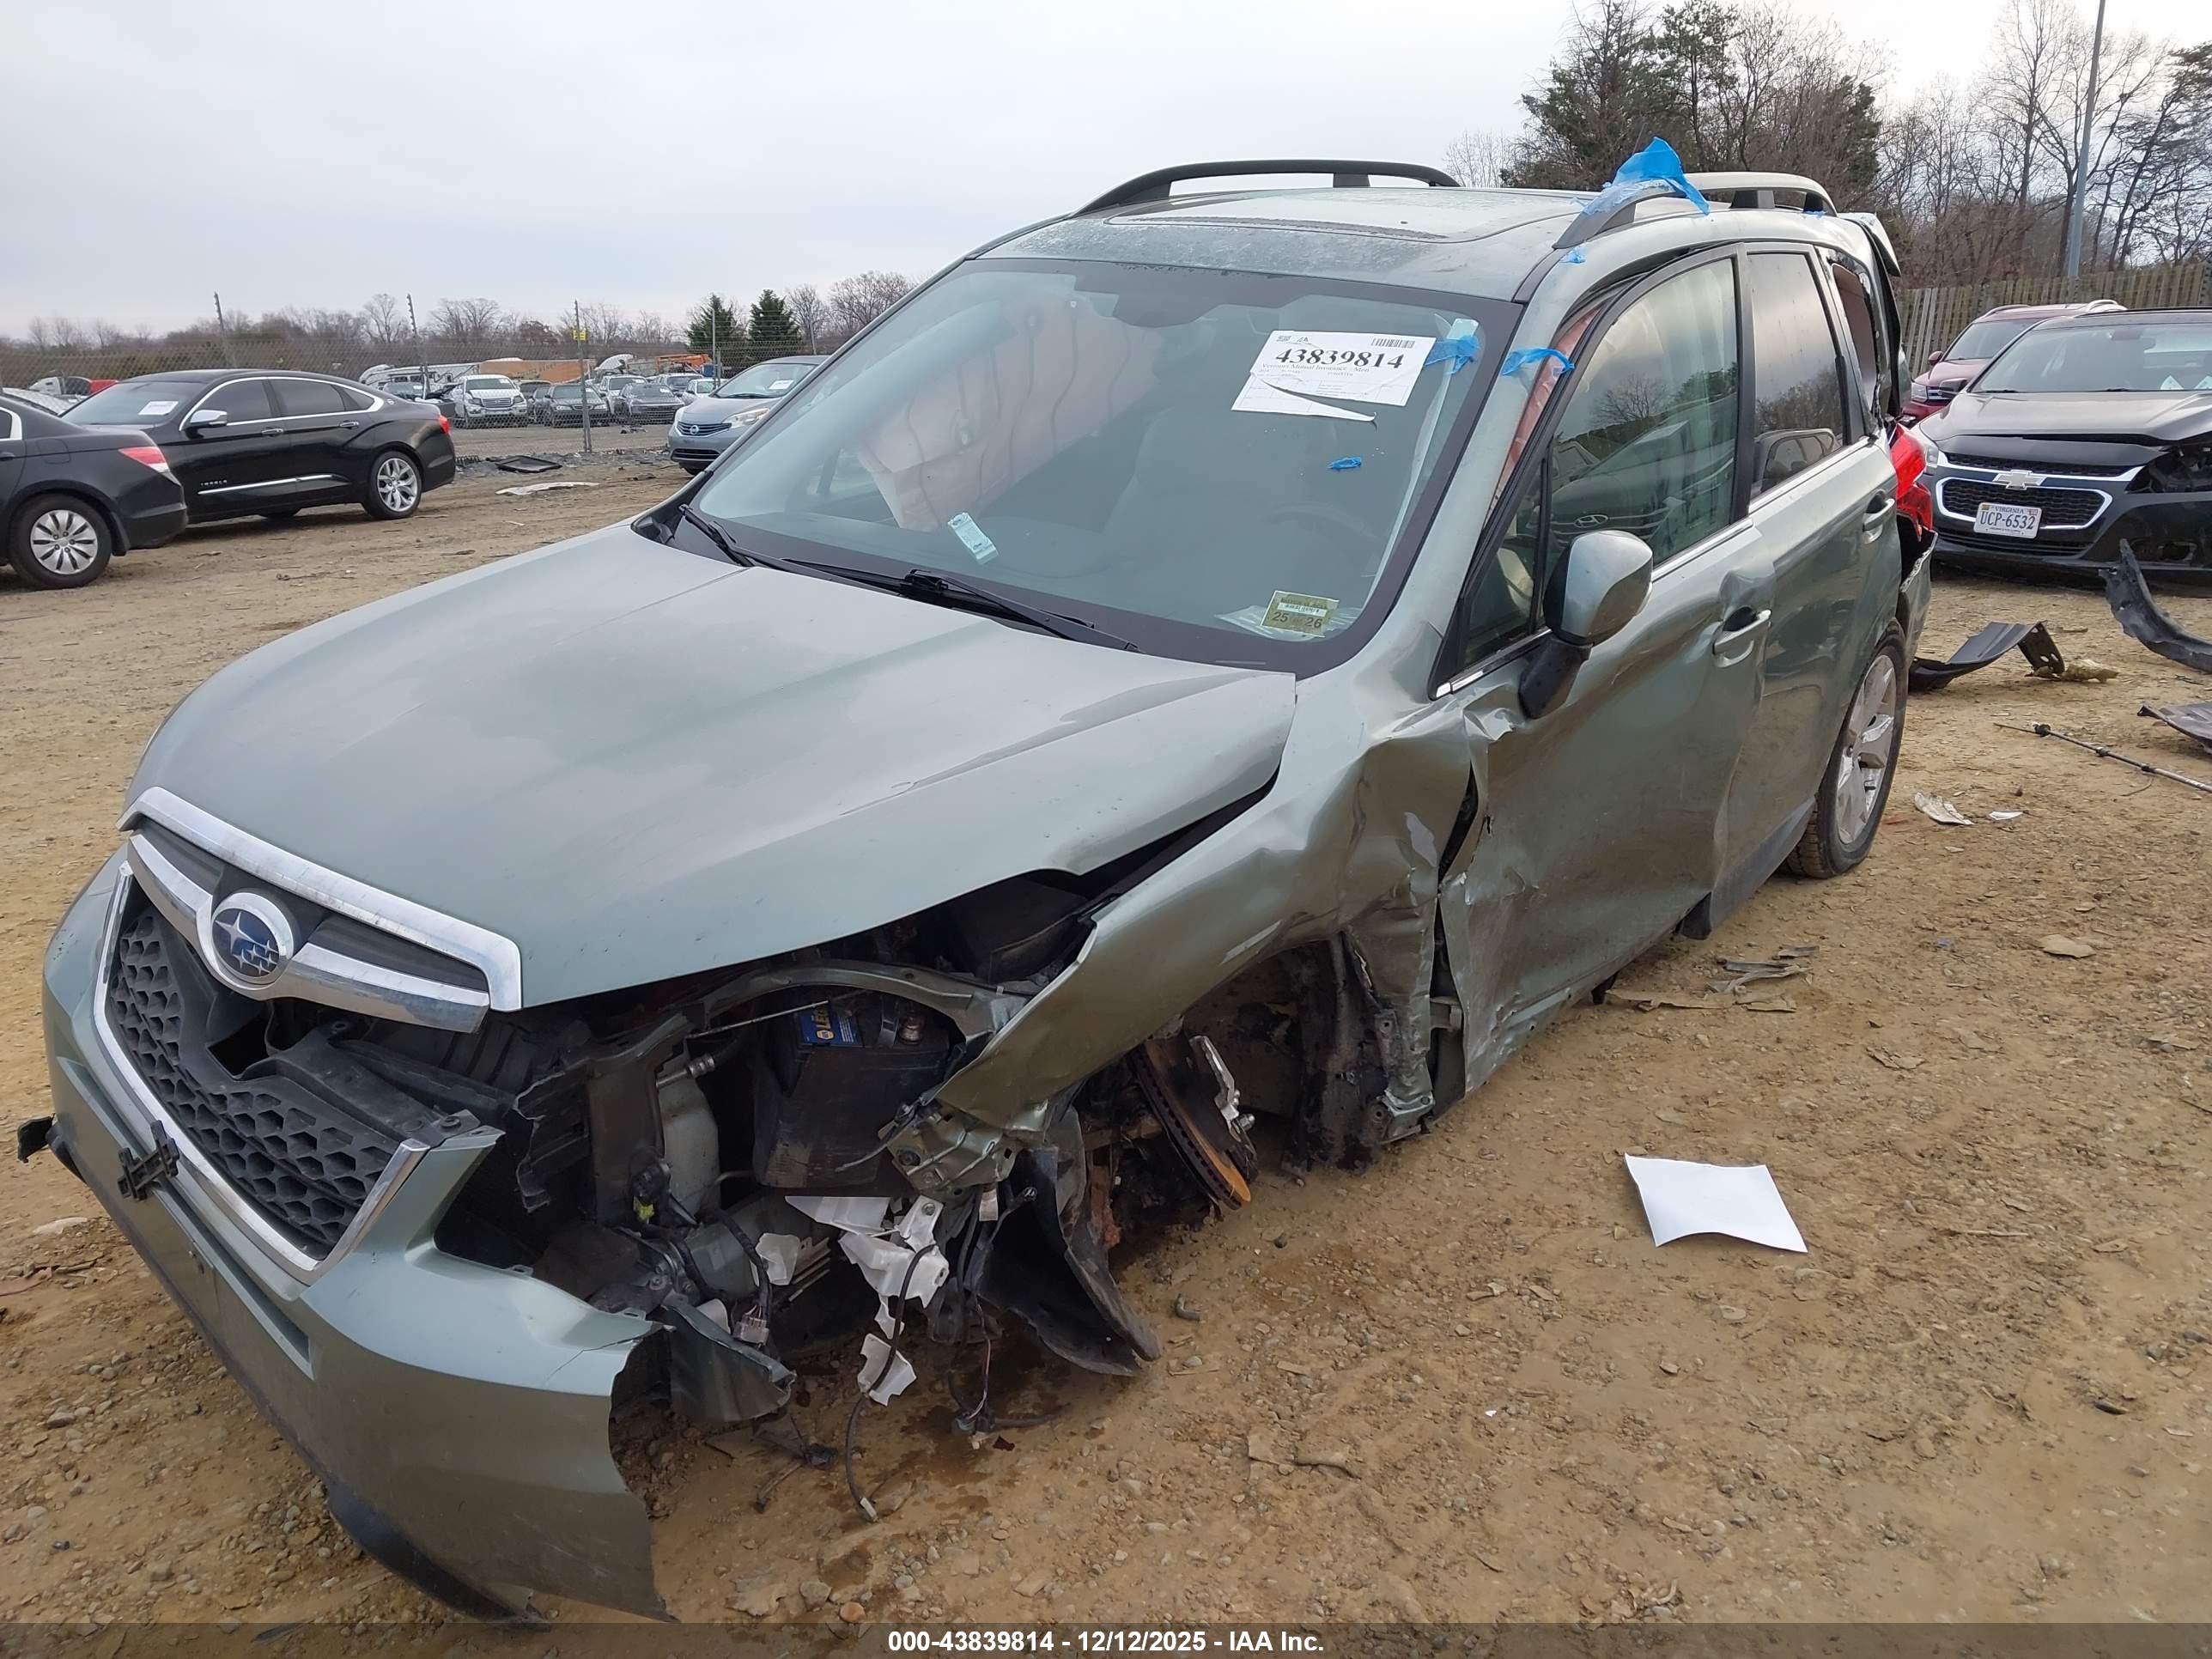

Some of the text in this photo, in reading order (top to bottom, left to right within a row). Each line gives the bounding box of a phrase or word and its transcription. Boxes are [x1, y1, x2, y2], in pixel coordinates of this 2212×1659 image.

[1275, 348, 1404, 369] 43839814
[1980, 511, 2036, 530] UCP-6532
[1272, 611, 1289, 623] 25
[1305, 617, 1323, 629] 26
